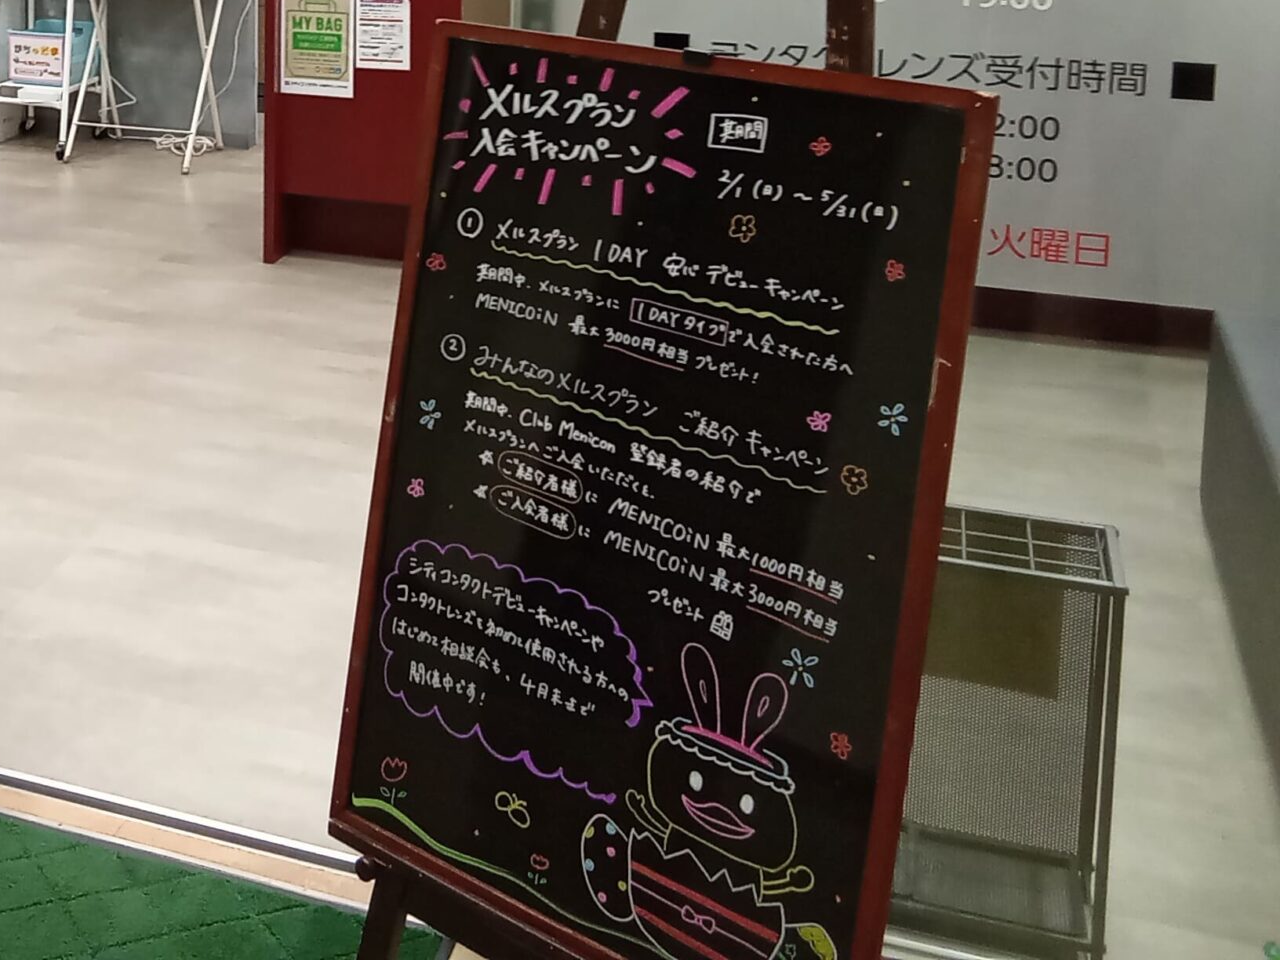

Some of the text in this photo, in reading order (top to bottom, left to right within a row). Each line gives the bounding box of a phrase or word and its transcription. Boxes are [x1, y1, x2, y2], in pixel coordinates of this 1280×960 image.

[292, 16, 343, 32] MY BAG
[478, 84, 637, 128] メルスプラン
[719, 117, 764, 143] 期間
[470, 127, 658, 174] 入会キャンペーン
[496, 219, 580, 251] メルスプラン
[987, 224, 1110, 267] 火曜日
